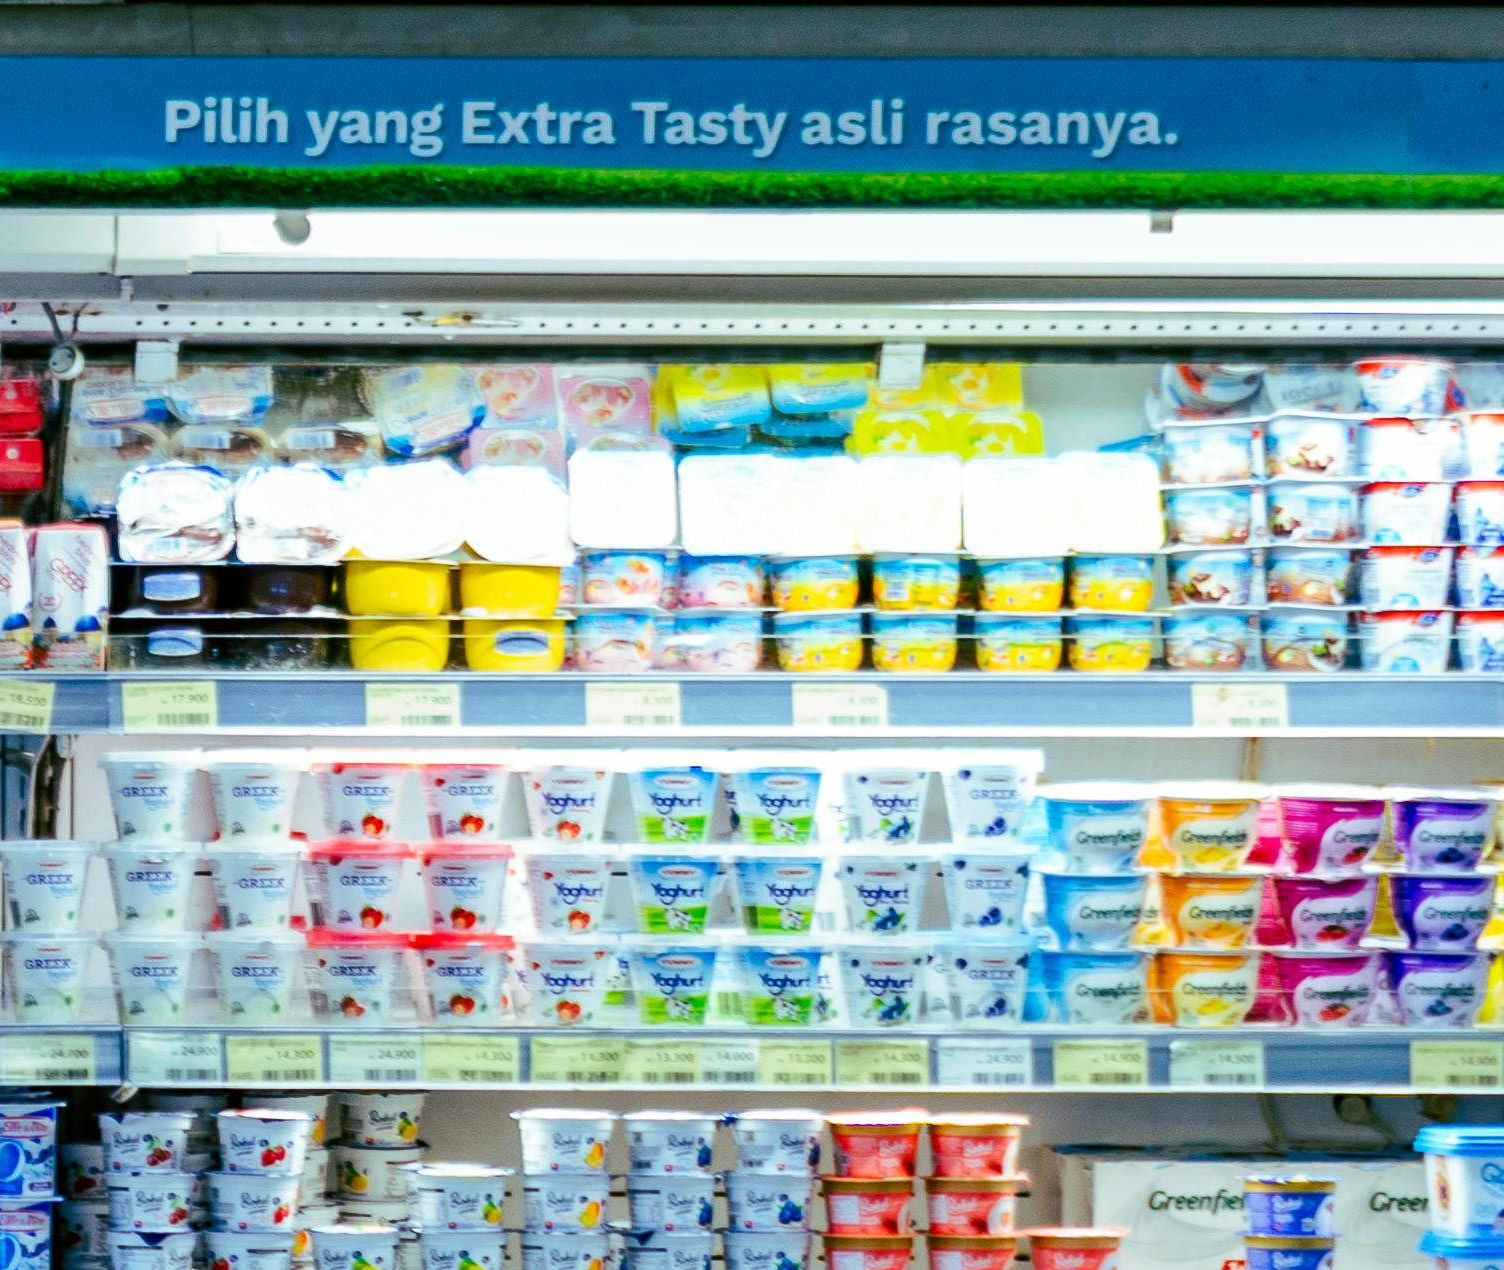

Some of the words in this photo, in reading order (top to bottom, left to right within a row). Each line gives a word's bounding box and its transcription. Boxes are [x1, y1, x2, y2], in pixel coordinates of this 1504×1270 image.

[166, 97, 289, 143] Pilih
[308, 107, 442, 157] yang
[462, 101, 613, 144] Extra
[634, 102, 786, 156] Tasty
[803, 99, 902, 145] asli
[927, 111, 1176, 157] rasanya.
[543, 793, 594, 814] Yoghurt
[649, 793, 701, 814] Yoghurt
[757, 793, 809, 814] Yoghurt
[652, 883, 704, 905] Yoghurt
[856, 884, 908, 907] Yoghurt
